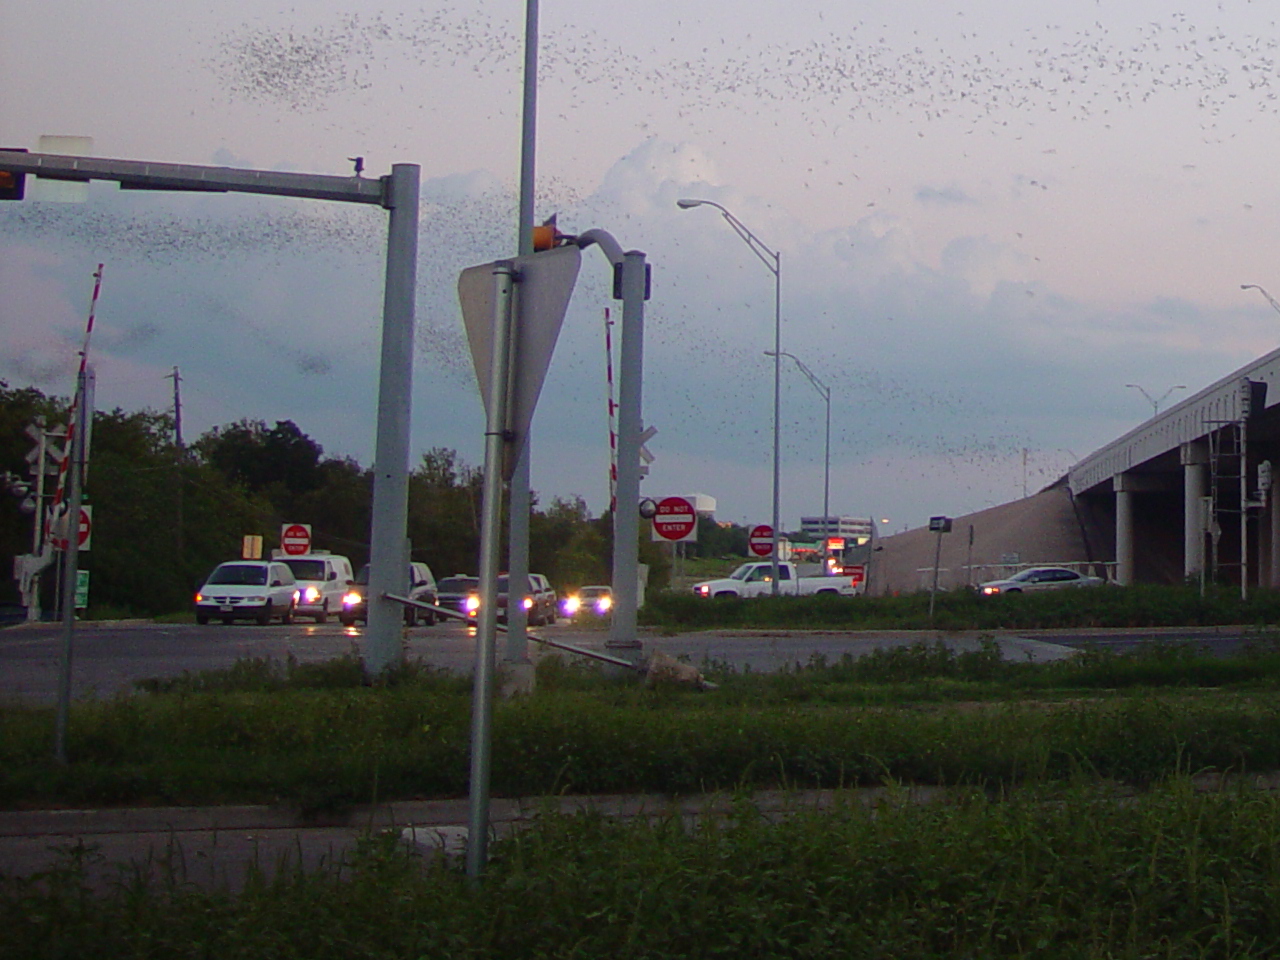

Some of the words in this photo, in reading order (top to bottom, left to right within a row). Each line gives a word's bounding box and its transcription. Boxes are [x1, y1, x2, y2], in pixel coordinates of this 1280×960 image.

[659, 505, 670, 513] DO
[673, 505, 688, 513] NOT
[662, 523, 686, 531] ENTER
